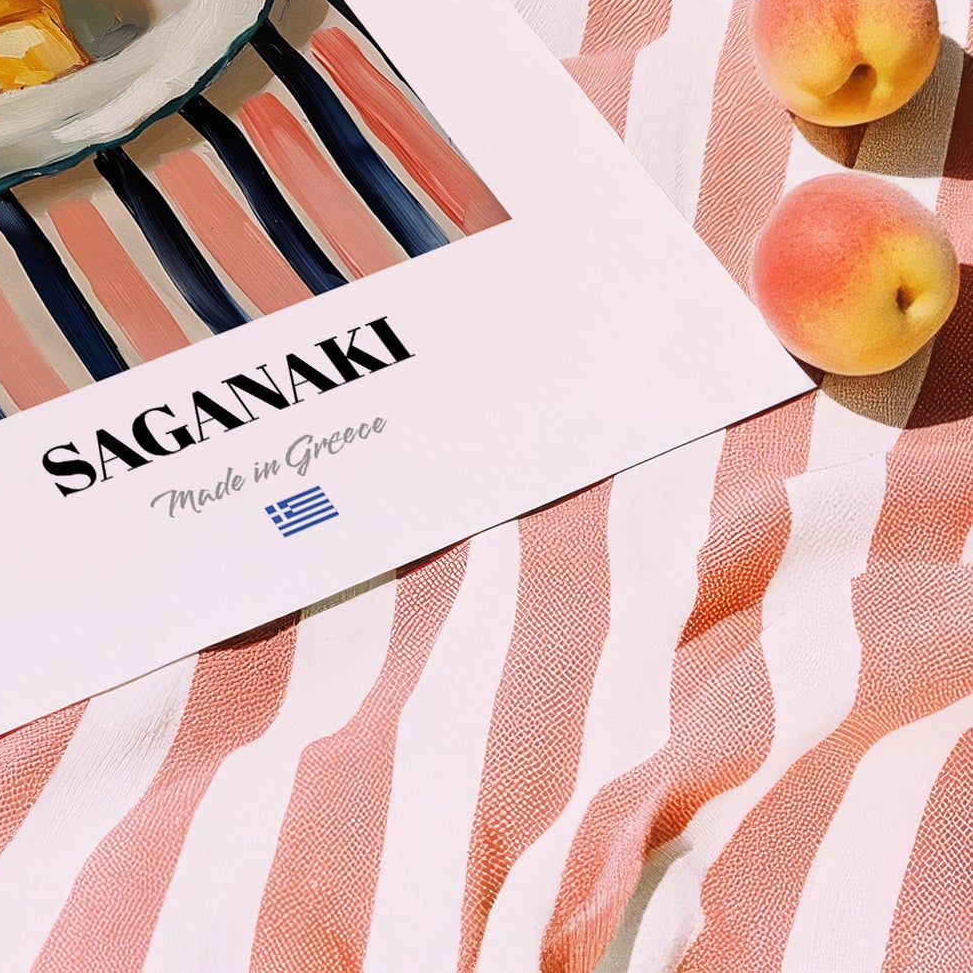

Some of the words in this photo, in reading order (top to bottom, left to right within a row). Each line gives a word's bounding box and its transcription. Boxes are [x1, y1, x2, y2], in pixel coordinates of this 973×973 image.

[42, 316, 416, 497] SAGANAKI
[150, 467, 246, 518] Made
[253, 457, 281, 484] in
[284, 416, 388, 477] Greece
